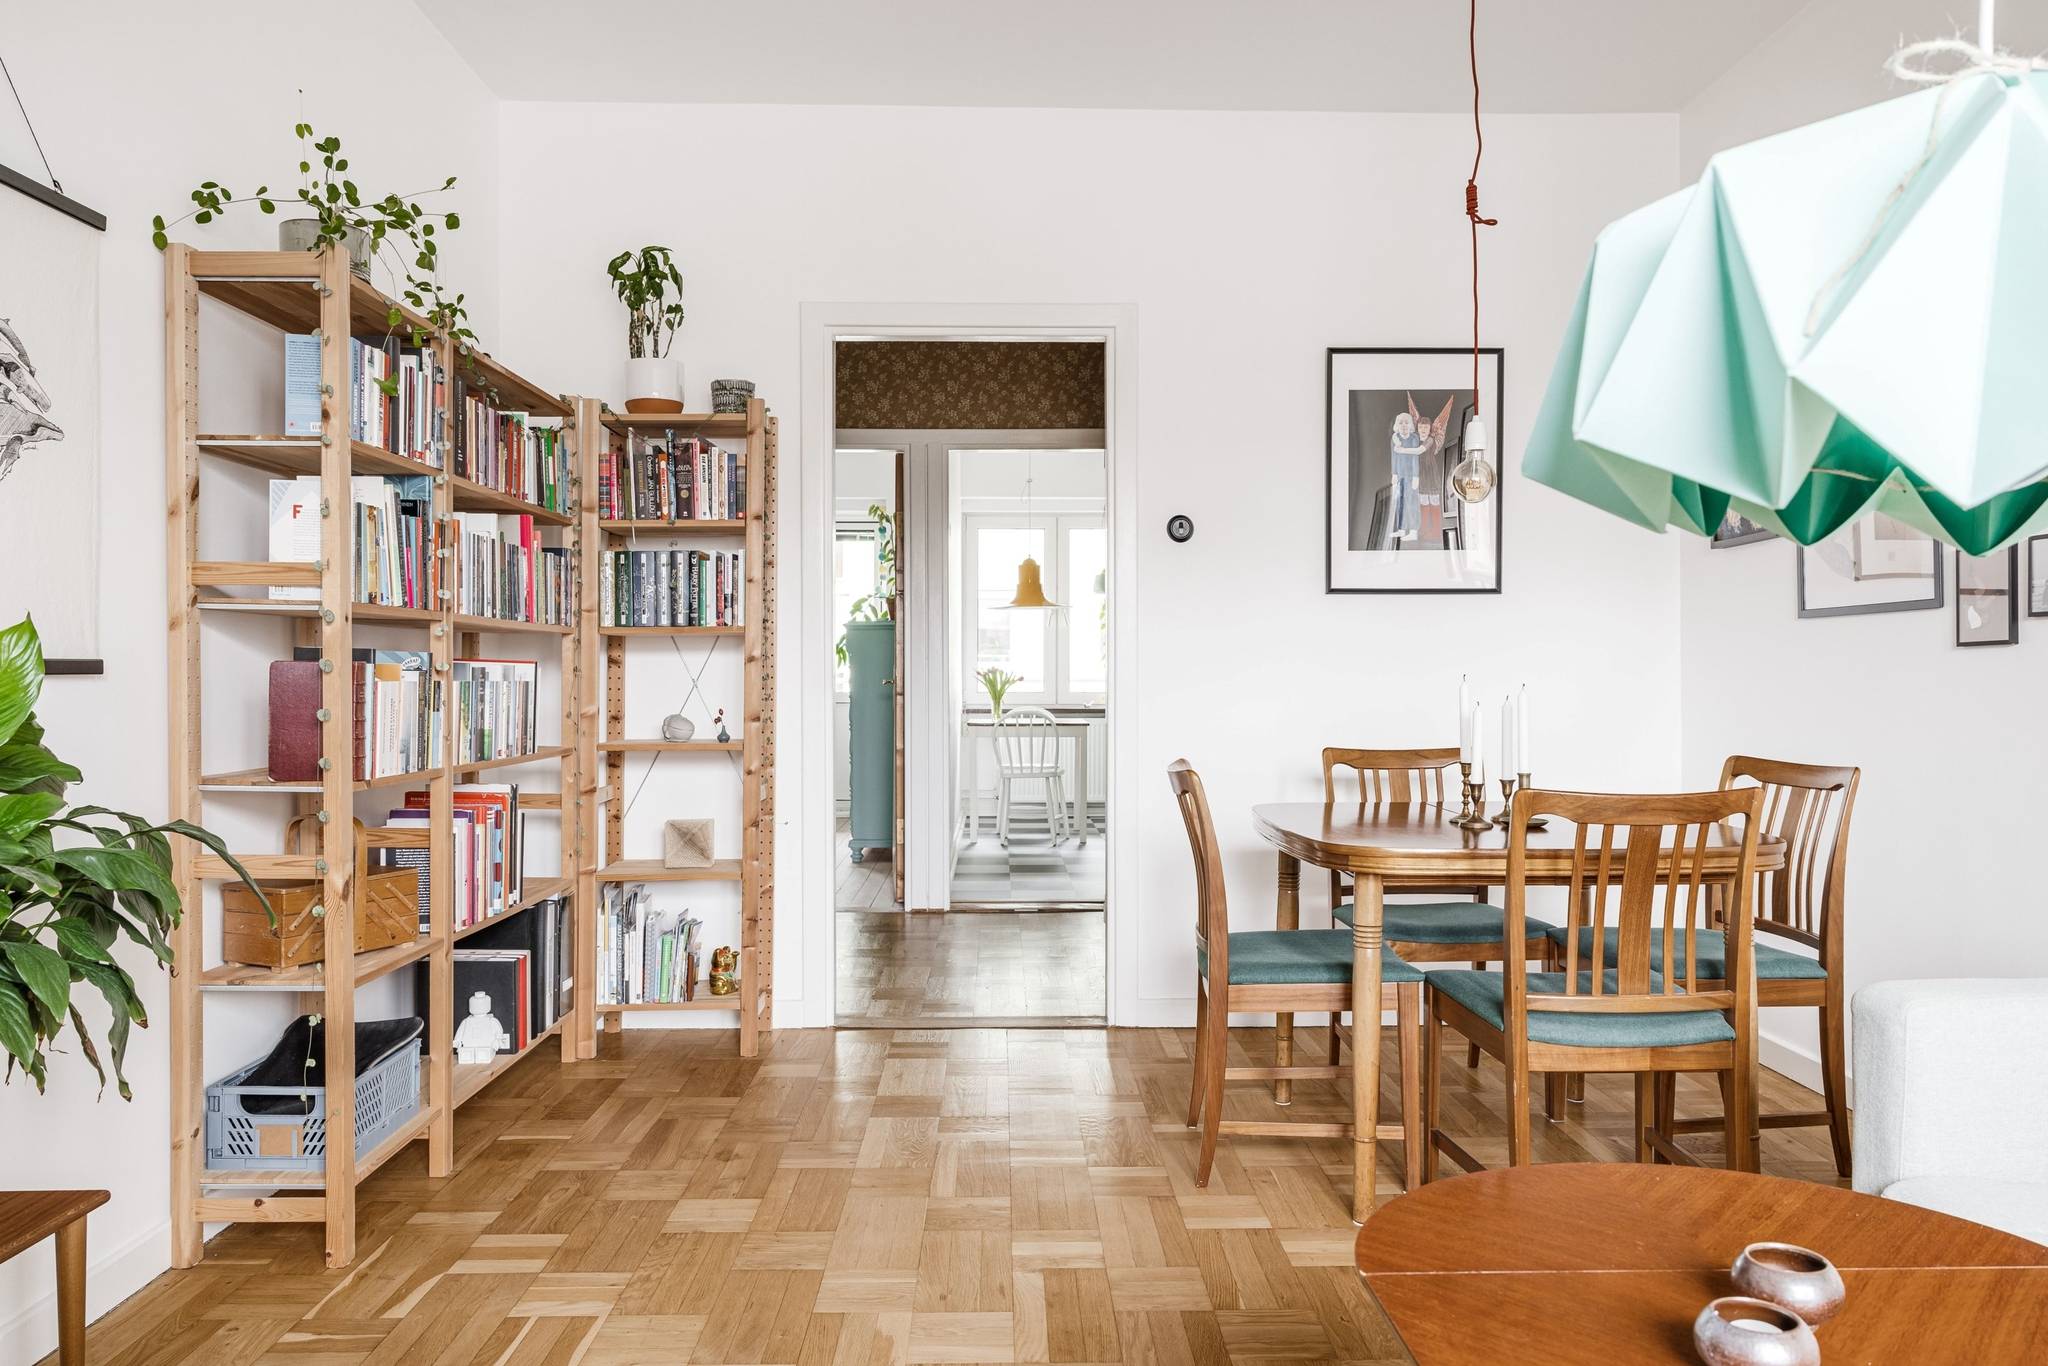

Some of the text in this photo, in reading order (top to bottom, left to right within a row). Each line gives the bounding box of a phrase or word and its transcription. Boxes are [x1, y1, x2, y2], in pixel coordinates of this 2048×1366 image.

[292, 504, 303, 519] F
[648, 490, 656, 514] GUILLOU
[691, 587, 699, 610] POTTER
